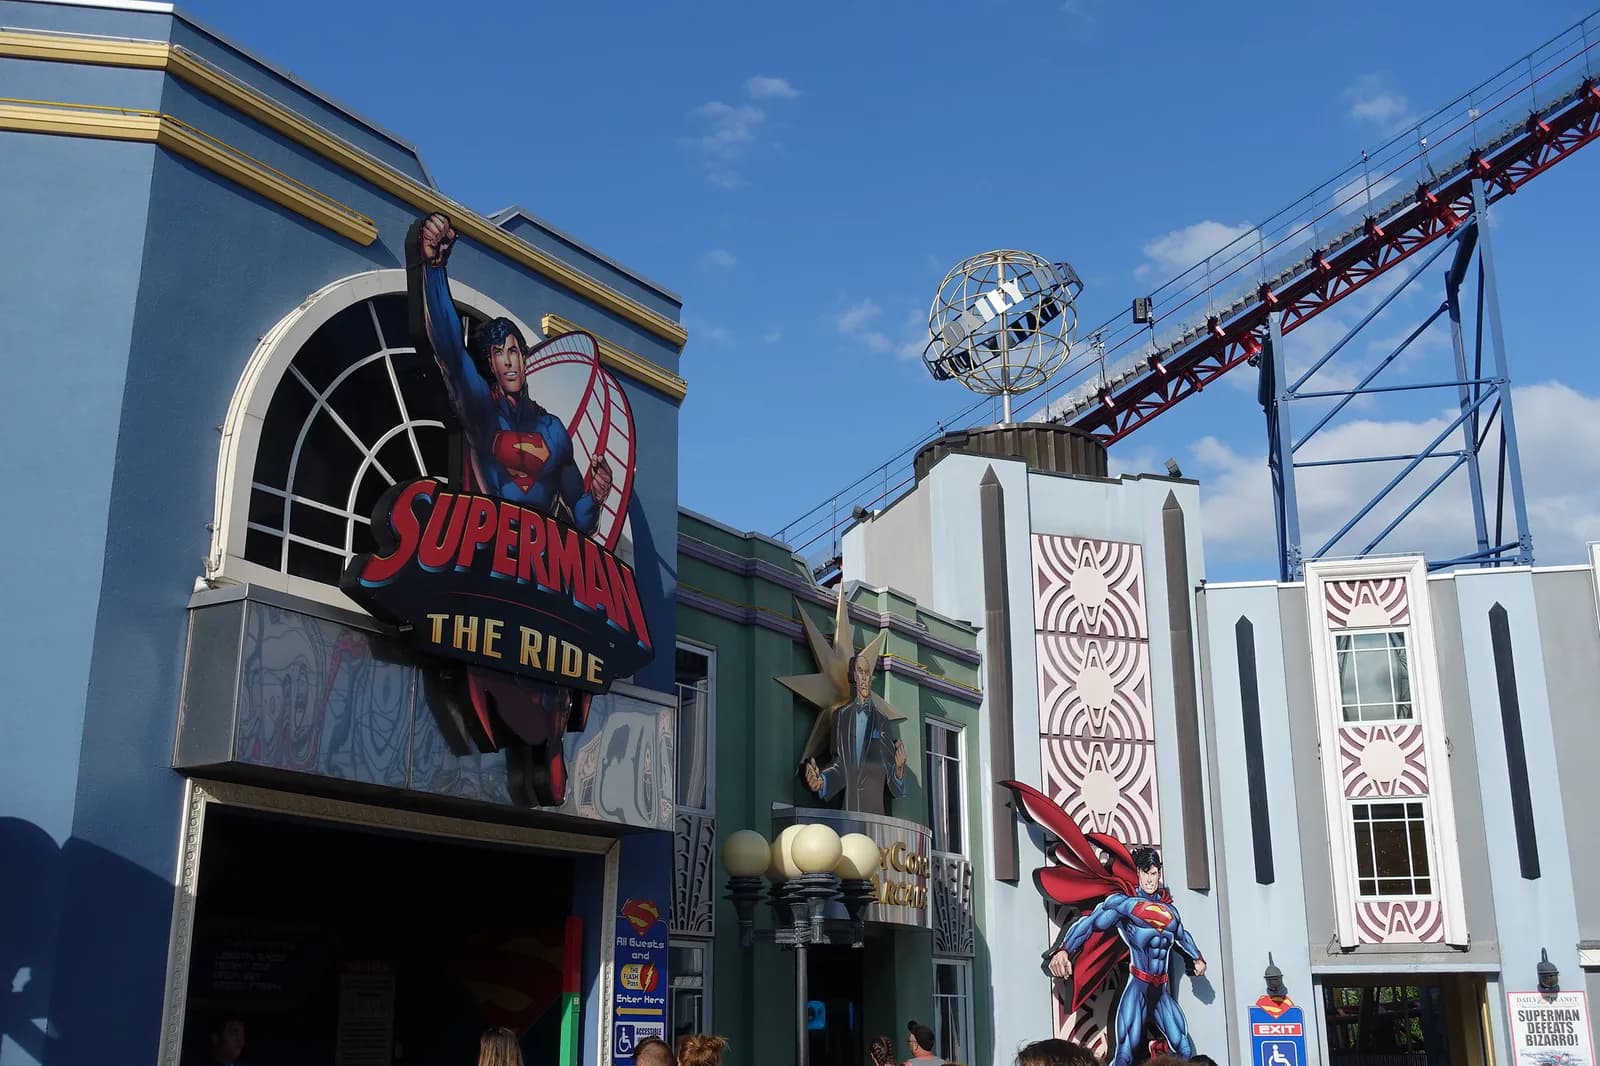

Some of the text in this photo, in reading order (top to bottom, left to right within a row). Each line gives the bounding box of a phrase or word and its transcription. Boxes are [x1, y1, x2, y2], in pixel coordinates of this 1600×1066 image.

[359, 479, 652, 649] SUPERMAN
[426, 613, 604, 685] THE RIDE
[616, 937, 665, 949] All Guests
[631, 951, 650, 960] and
[616, 994, 665, 1004] Enter Here
[1517, 1009, 1580, 1022] SUPERMAN
[1258, 1025, 1296, 1034] EXIT
[1527, 1021, 1574, 1034] DEFEATS
[1525, 1033, 1580, 1046] BIZARRO!
